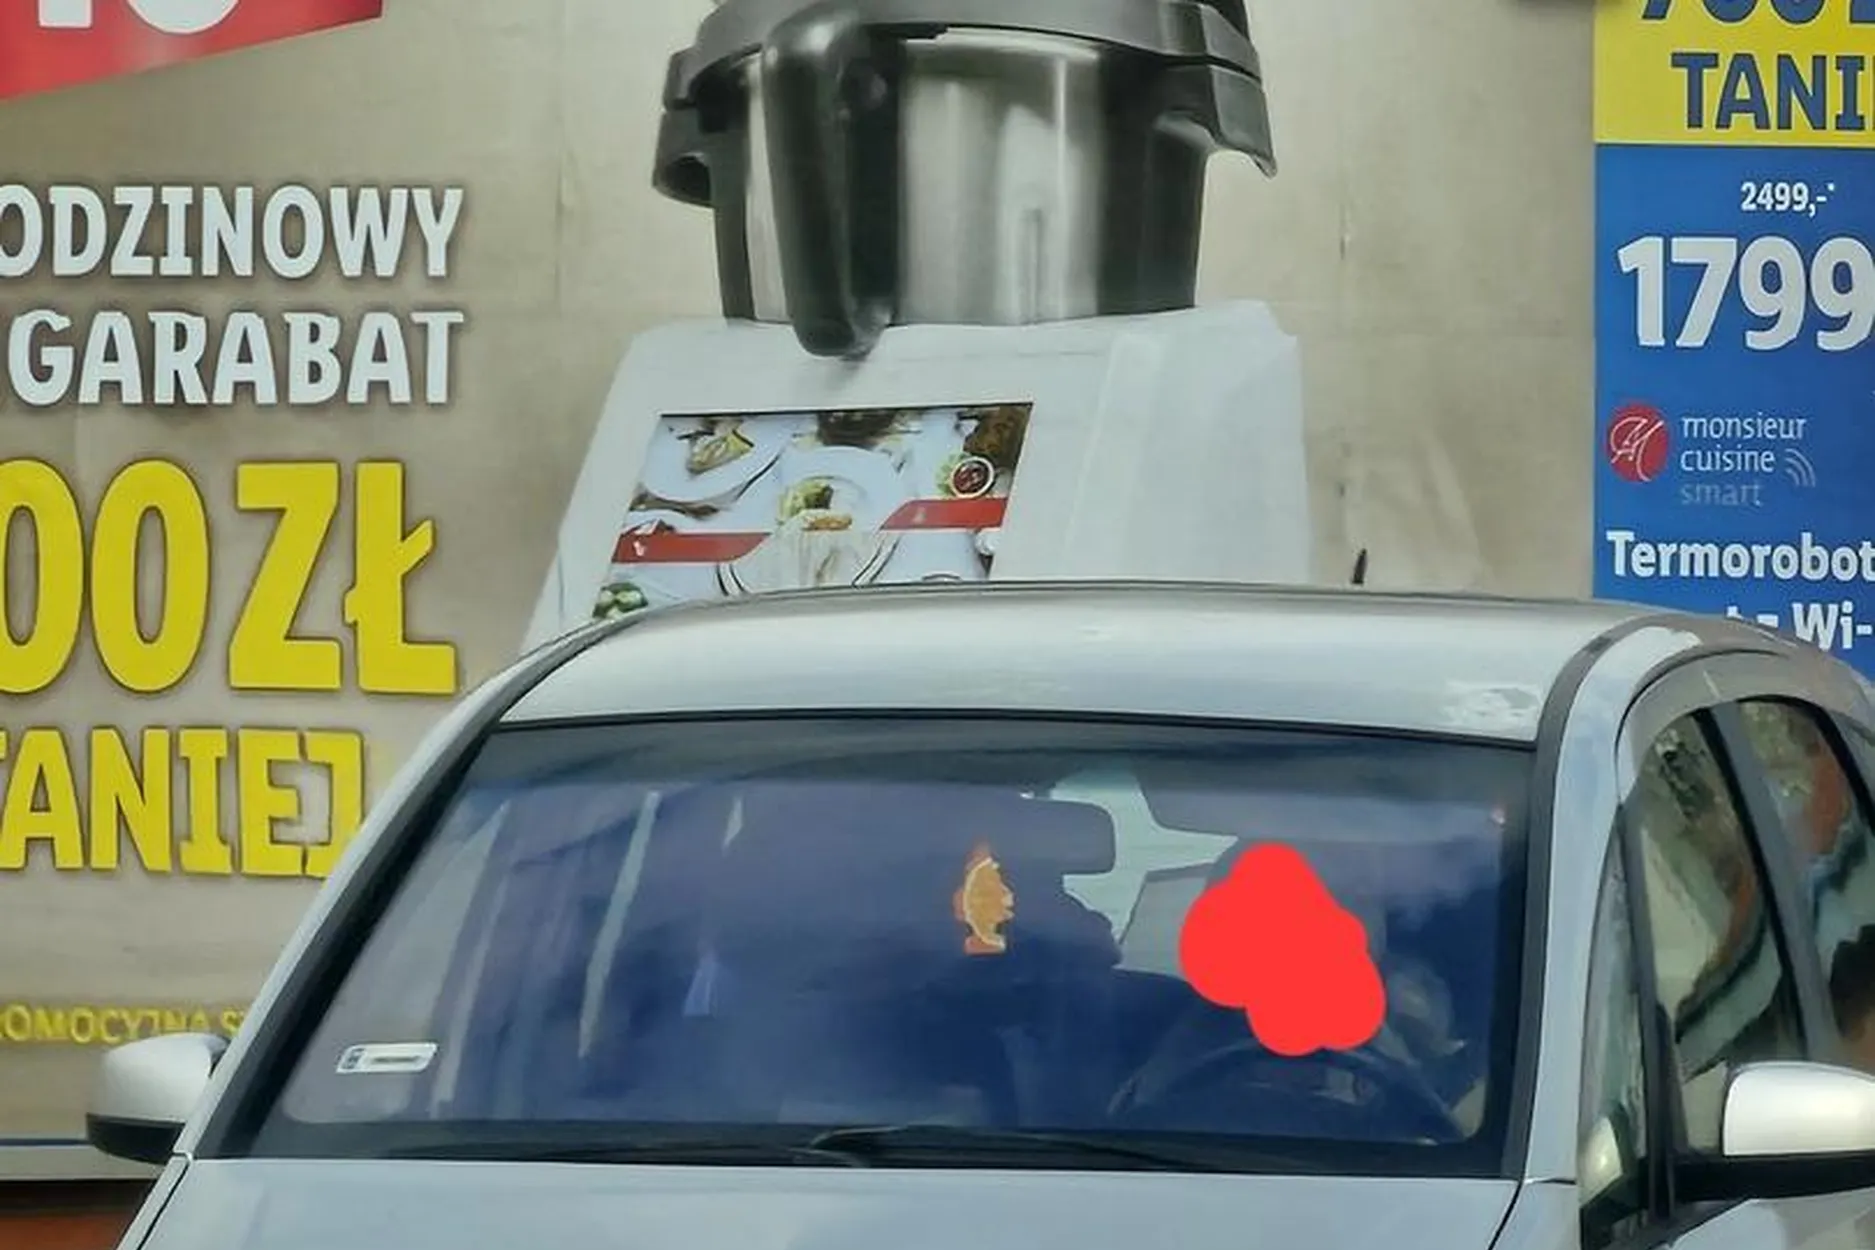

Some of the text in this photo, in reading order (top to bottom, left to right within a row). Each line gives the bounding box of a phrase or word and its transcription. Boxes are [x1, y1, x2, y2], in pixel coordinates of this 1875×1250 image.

[1671, 52, 1875, 130] TANI
[1617, 235, 1875, 351] 1799
[8, 309, 465, 406] GARABAT
[1680, 443, 1776, 472] cuisine
[1681, 411, 1807, 439] monsieur
[1680, 480, 1763, 506] smart
[1606, 529, 1875, 582] Termorobot
[0, 728, 364, 878] ANIEJ
